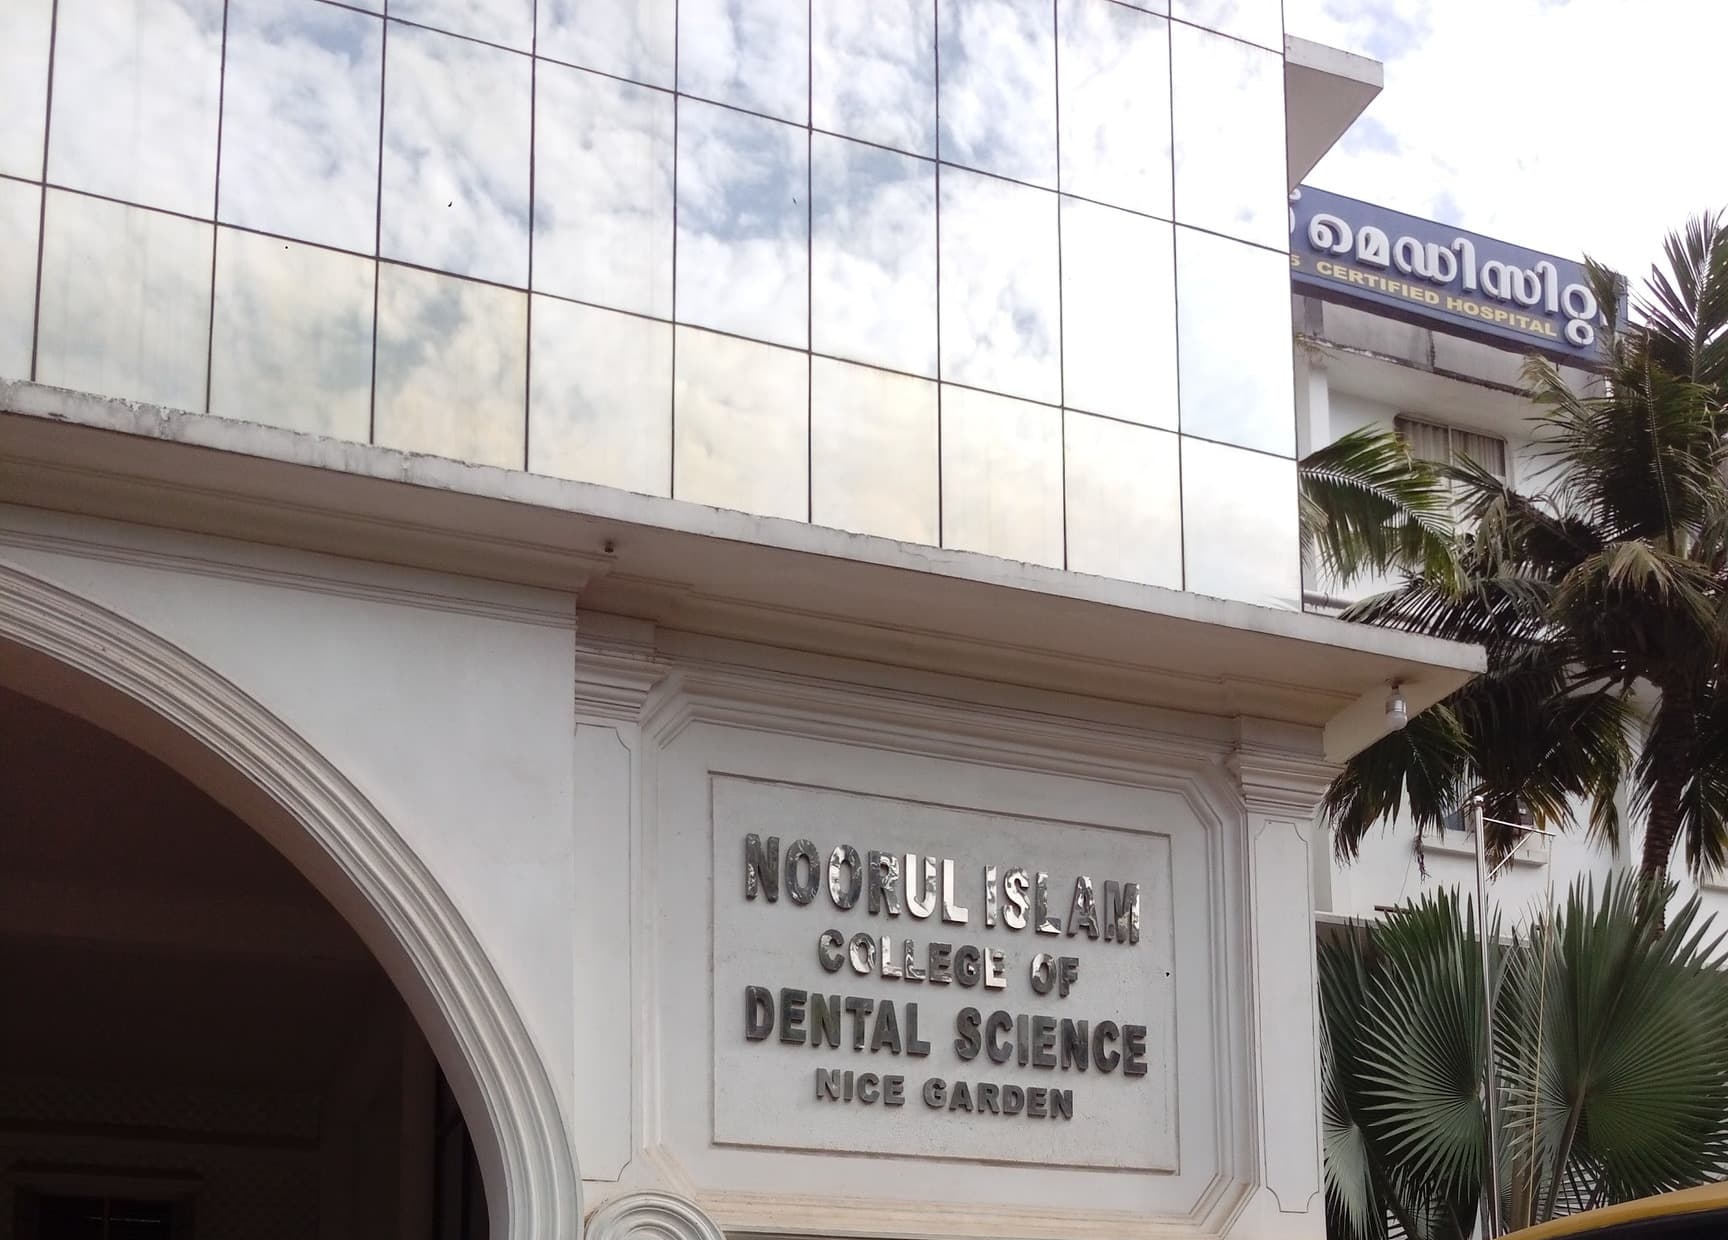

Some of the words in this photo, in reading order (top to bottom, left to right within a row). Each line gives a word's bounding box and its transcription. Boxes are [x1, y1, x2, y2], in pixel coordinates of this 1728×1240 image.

[1316, 261, 1440, 305] CERTIFIED
[1446, 296, 1558, 337] HOSPITAL
[745, 832, 969, 925] NOORUL
[984, 863, 1141, 944] ISLAM
[818, 929, 1007, 989] COLLEGE
[1030, 951, 1080, 997] OF
[745, 985, 931, 1056] DENTAL
[954, 1006, 1148, 1075] SCIENCE
[815, 1067, 905, 1106] NICE
[922, 1077, 1074, 1119] GARDEN
